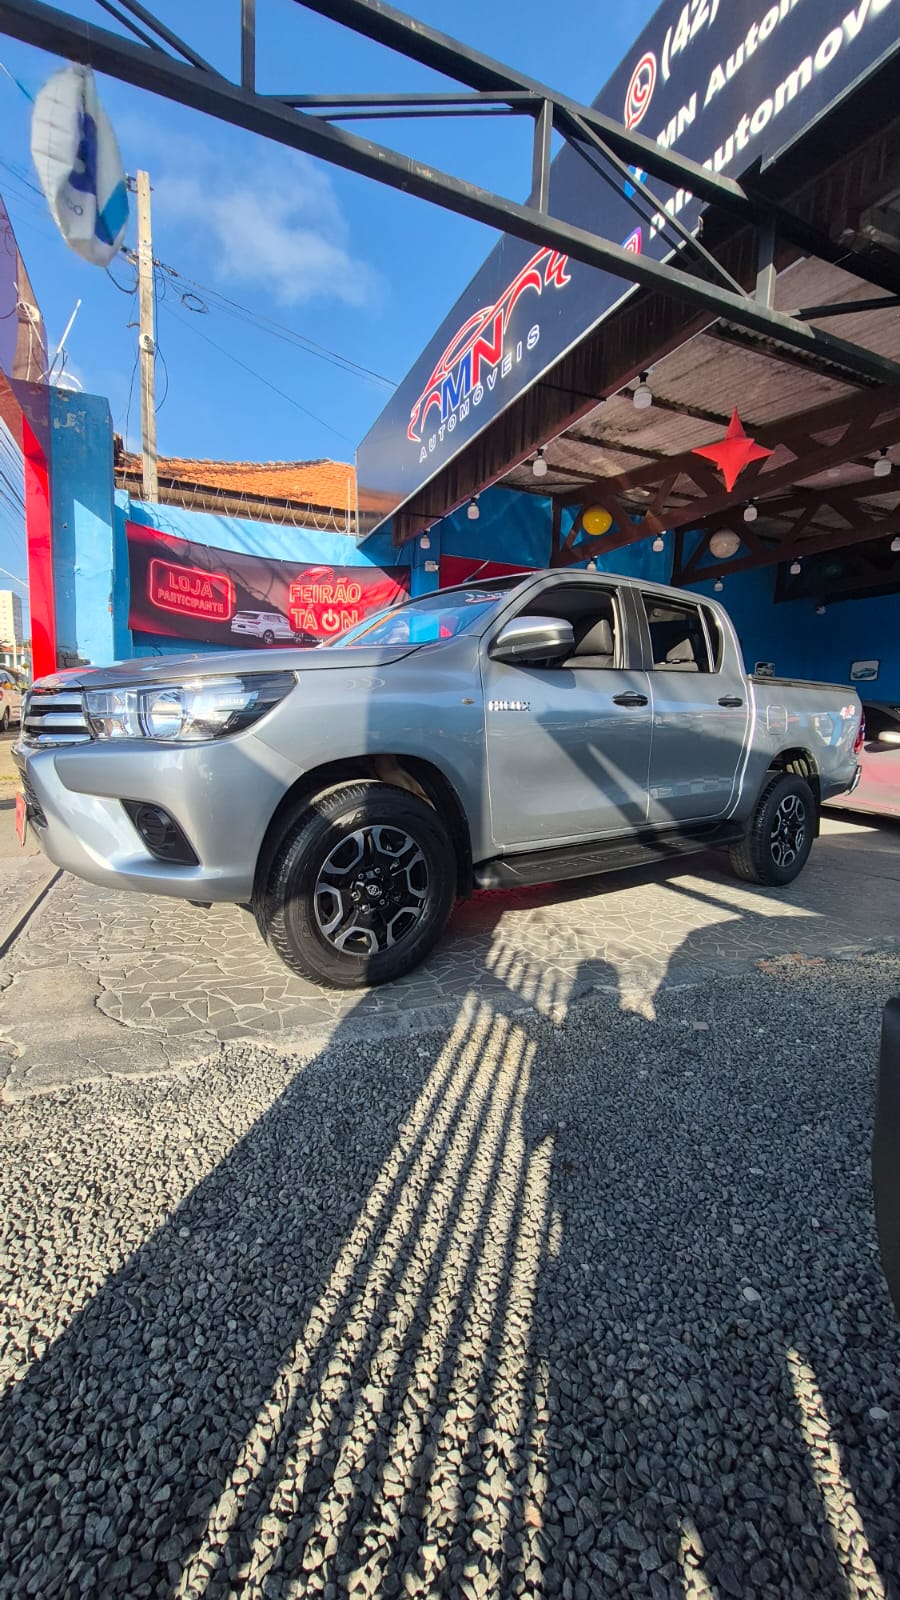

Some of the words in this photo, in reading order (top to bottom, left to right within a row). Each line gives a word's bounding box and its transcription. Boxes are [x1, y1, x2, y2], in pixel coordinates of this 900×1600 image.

[656, 91, 697, 149] MN
[441, 309, 505, 423] MN
[419, 324, 541, 463] AUTOMOVEIS
[169, 571, 213, 598] LOJA
[289, 577, 361, 604] FEIRÃO
[157, 588, 224, 614] PARTICIPANTE
[290, 603, 319, 630] TÁ
